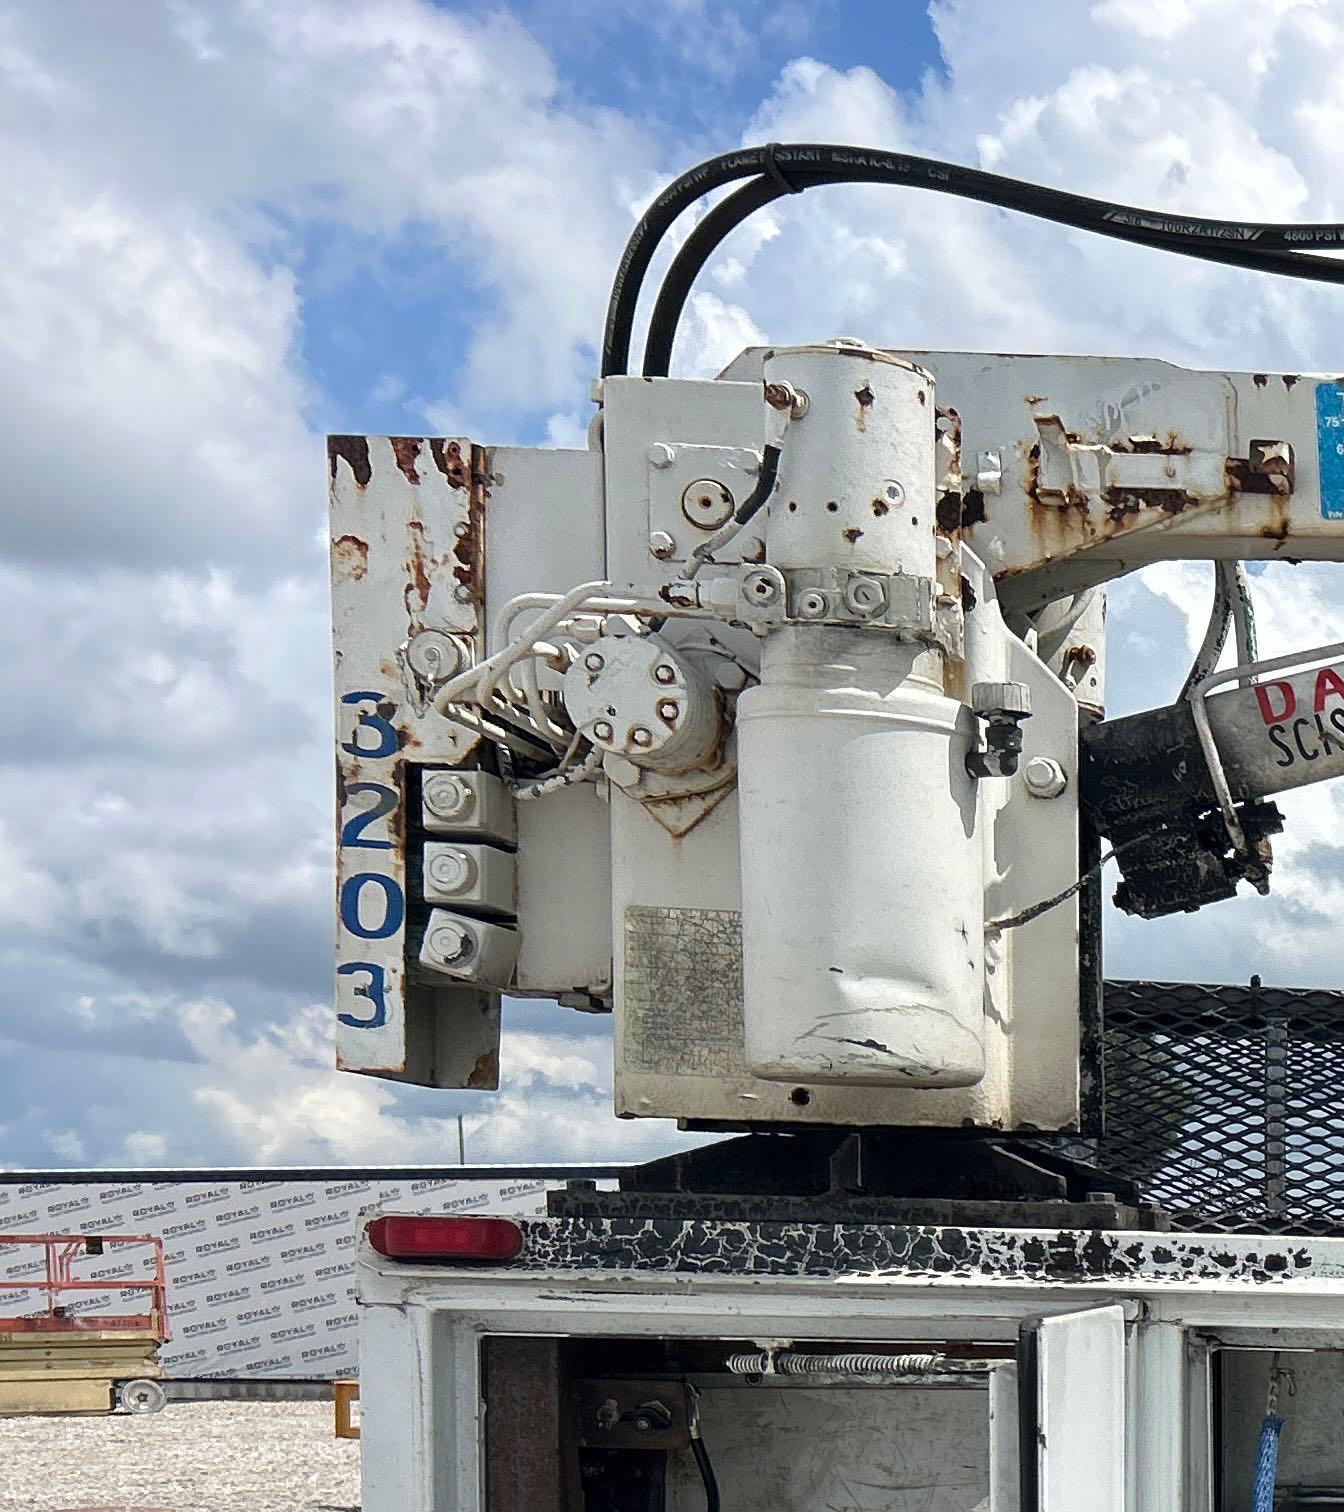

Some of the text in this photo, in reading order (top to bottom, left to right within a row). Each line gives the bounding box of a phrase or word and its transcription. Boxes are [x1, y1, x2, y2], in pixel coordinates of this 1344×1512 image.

[1316, 229, 1336, 241] PSI
[1325, 416, 1340, 427] 75
[326, 1183, 359, 1194] ROYAL
[186, 1190, 219, 1204] ROYAL
[270, 1195, 304, 1208] ROYAL
[443, 1196, 479, 1210] ROYAL
[48, 1200, 80, 1213] ROYAL
[134, 1204, 166, 1216] ROYAL
[216, 1209, 249, 1221] ROYAL
[305, 1214, 338, 1226] ROYAL
[80, 1217, 113, 1229] ROYAL
[162, 1222, 196, 1235] ROYAL
[250, 1227, 283, 1239] ROYAL
[196, 1240, 230, 1252] ROYAL
[281, 1246, 316, 1258] ROYAL
[226, 1259, 260, 1272] ROYAL
[316, 1266, 350, 1276] ROYAL
[91, 1266, 123, 1279] ROYAL
[173, 1271, 206, 1284] ROYAL
[260, 1277, 294, 1289] ROYAL
[206, 1289, 240, 1302] ROYAL
[291, 1295, 326, 1308] ROYAL
[237, 1308, 270, 1320] ROYAL
[183, 1321, 216, 1334] ROYAL
[271, 1327, 305, 1339] ROYAL
[217, 1339, 251, 1352] ROYAL
[164, 1352, 197, 1363] ROYAL
[302, 1346, 335, 1358] ROYAL
[246, 1358, 280, 1370] ROYAL
